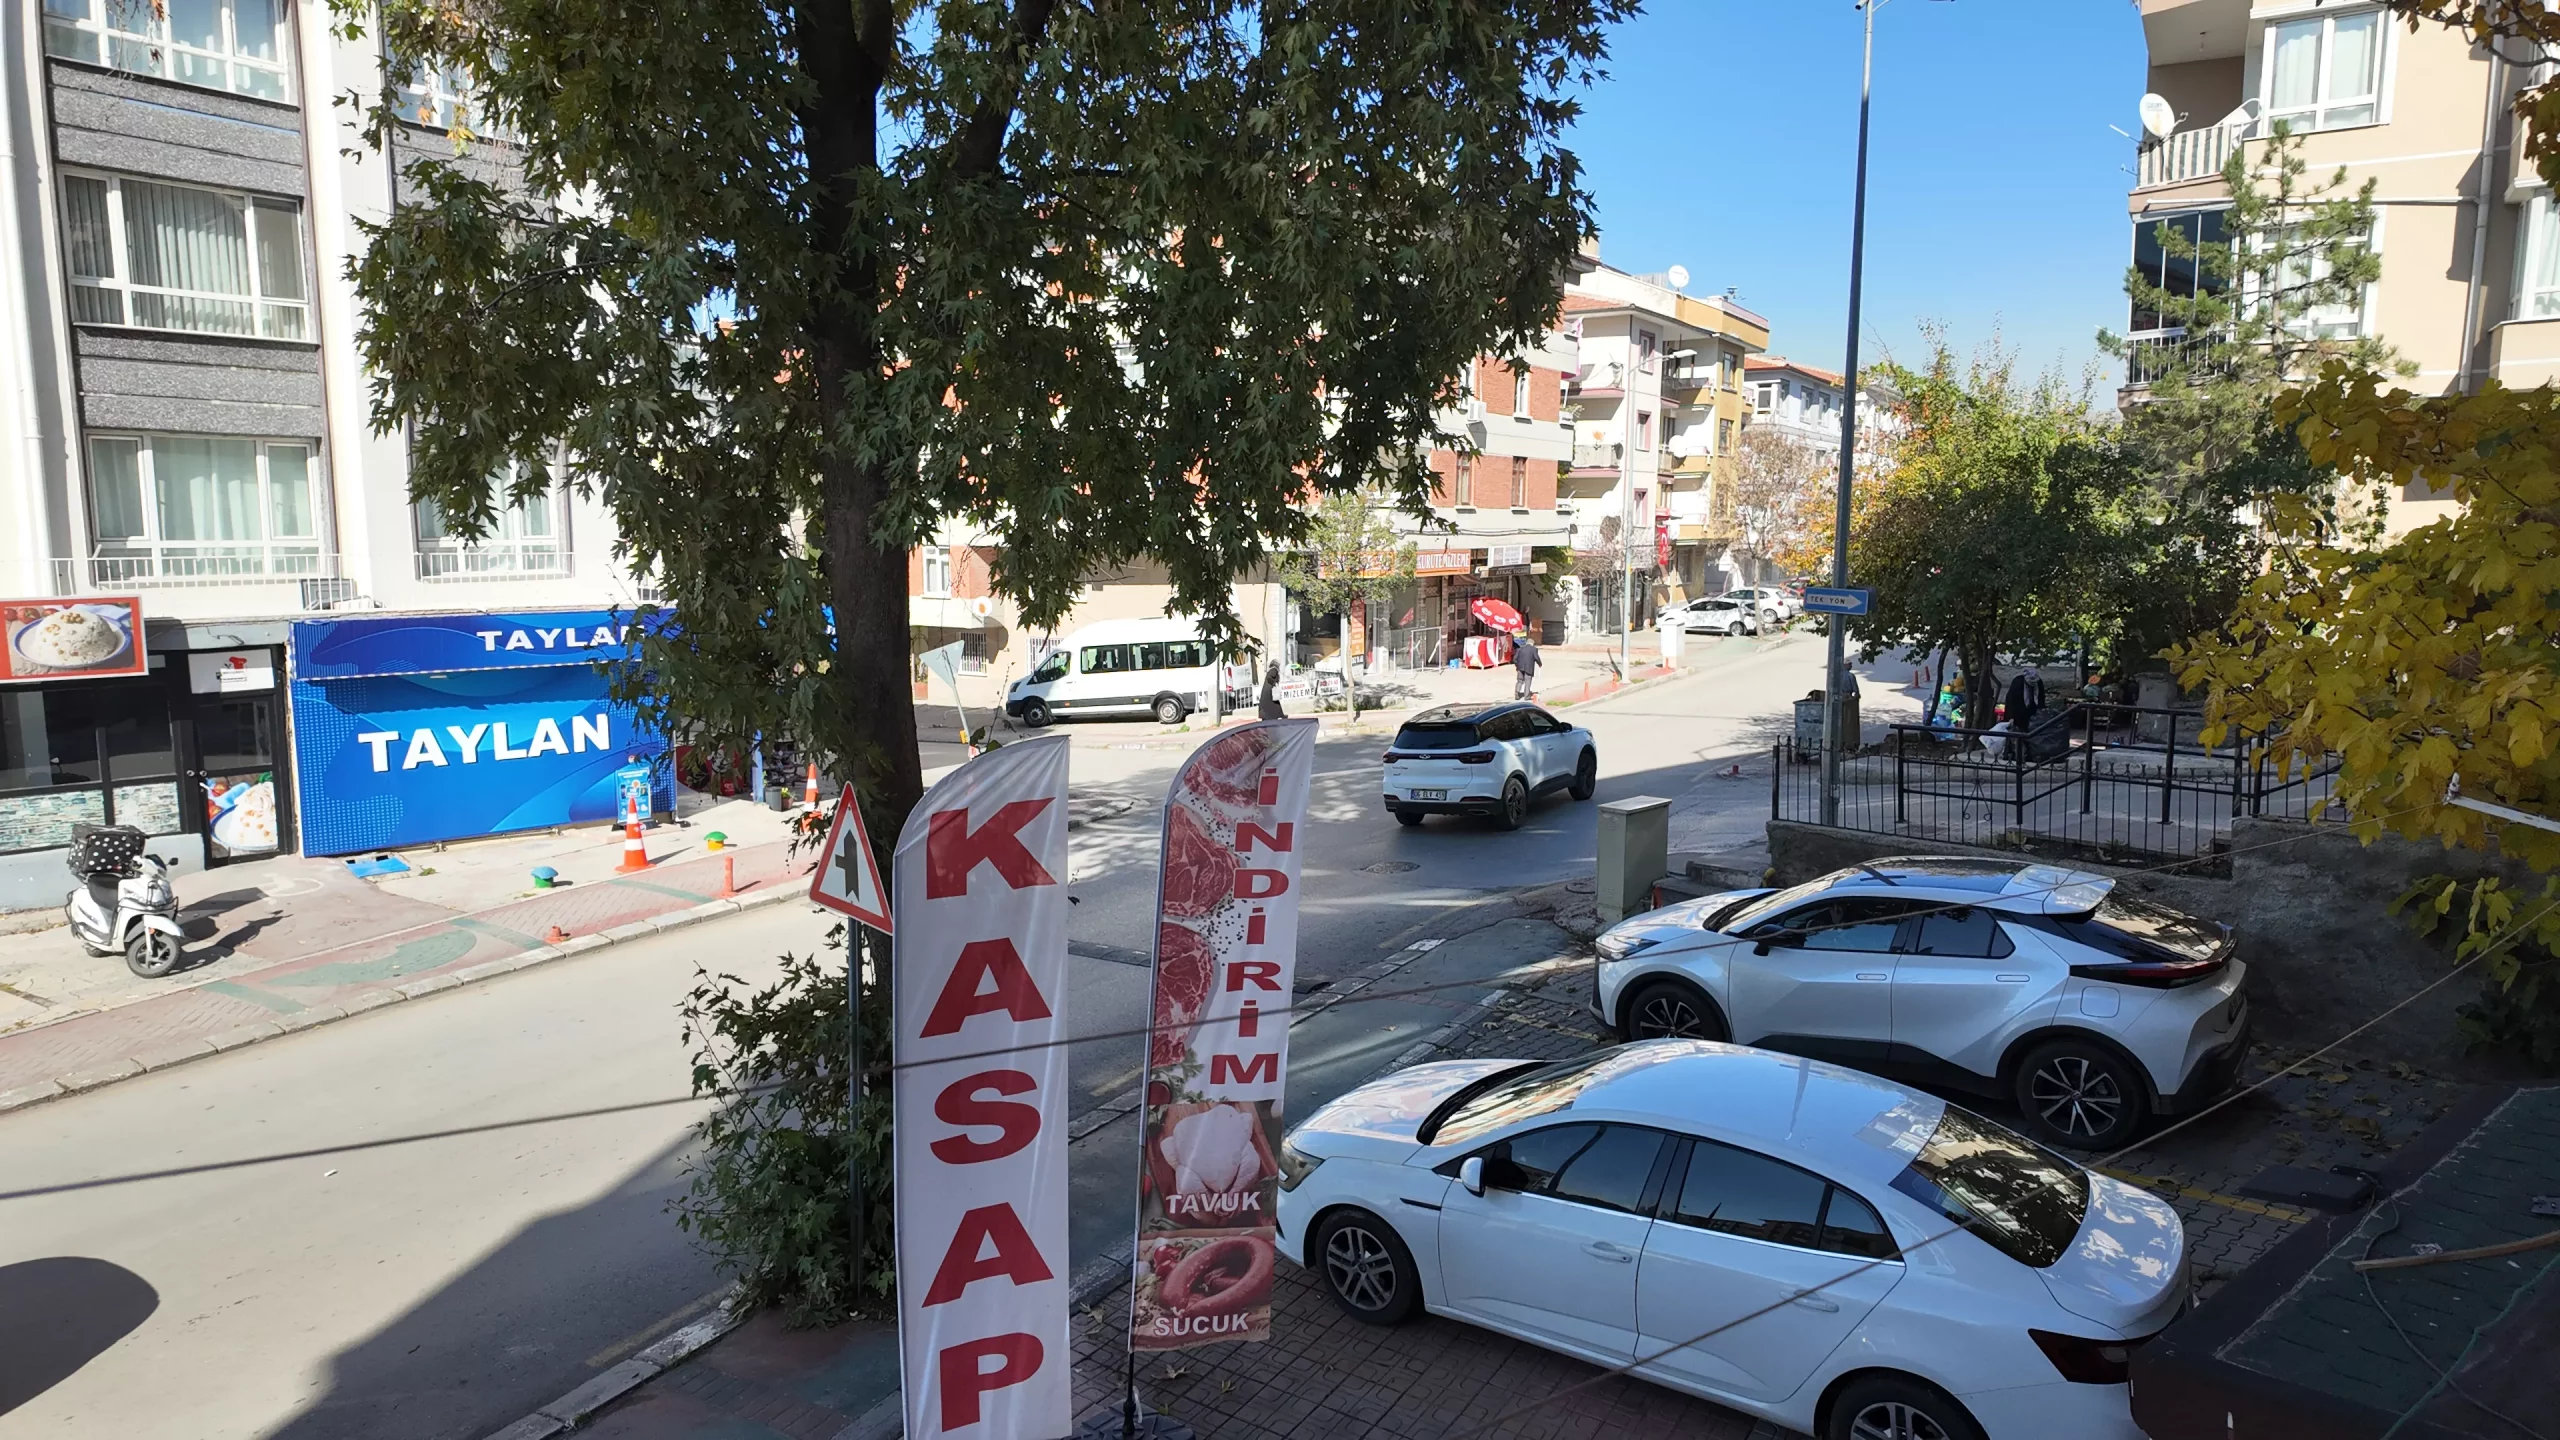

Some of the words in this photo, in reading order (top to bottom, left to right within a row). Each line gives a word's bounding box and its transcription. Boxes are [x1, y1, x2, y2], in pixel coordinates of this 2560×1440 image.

[1810, 595, 1824, 603] TEK
[358, 713, 611, 773] TAYLAN
[1209, 767, 1294, 1085] İNDİRİM
[919, 797, 1058, 1434] KASAP
[1166, 1191, 1261, 1214] TAVUK
[1154, 1312, 1249, 1336] SUCUK
